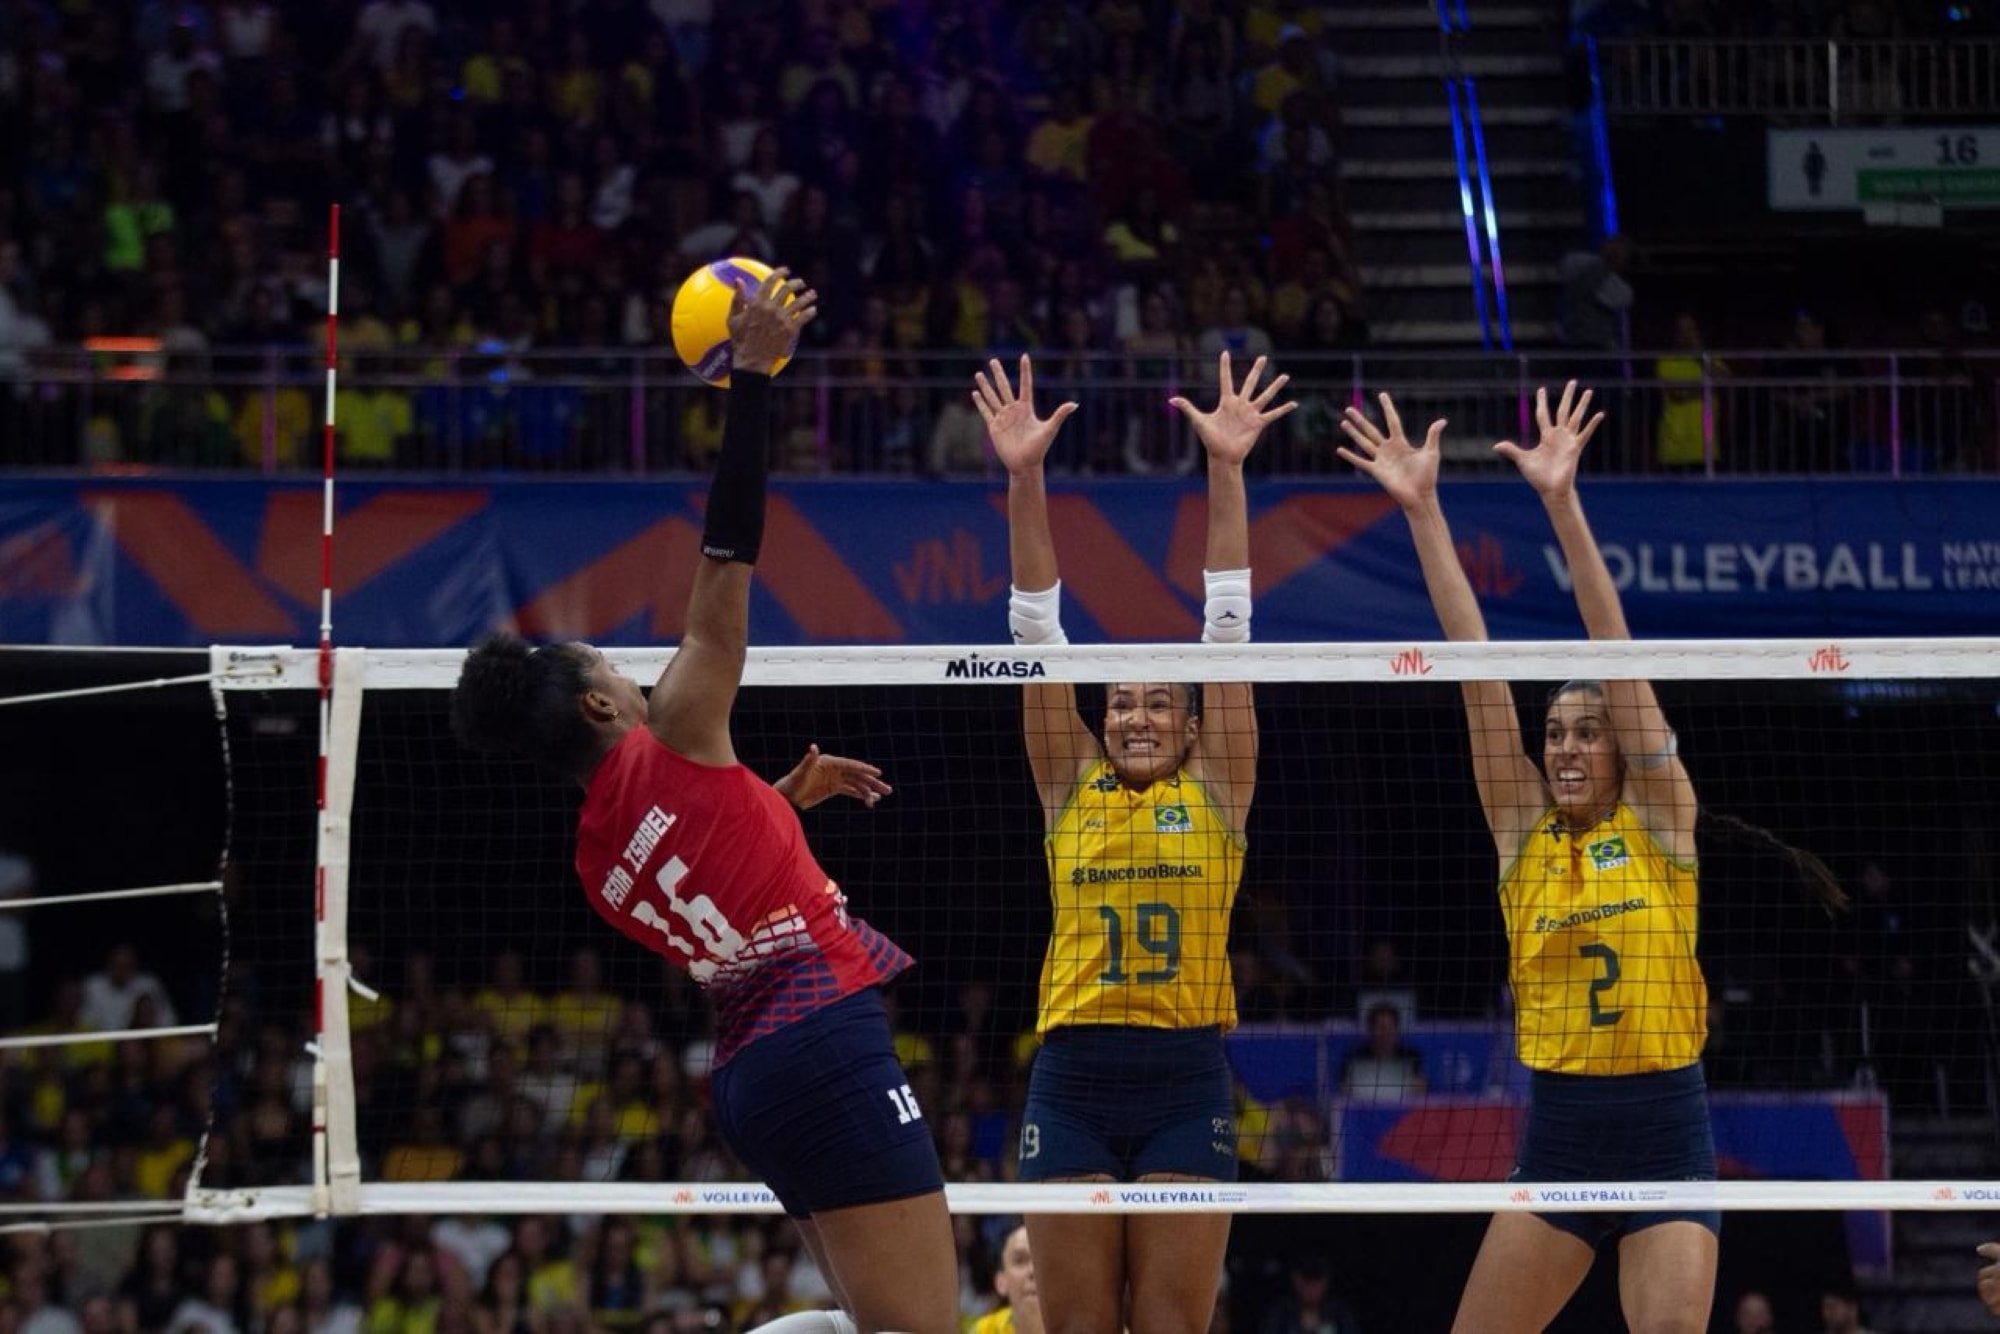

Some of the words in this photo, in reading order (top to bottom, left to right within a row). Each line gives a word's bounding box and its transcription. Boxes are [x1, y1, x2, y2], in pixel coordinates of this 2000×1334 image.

[1935, 135, 1978, 165] 16
[1543, 542, 1932, 591] VOLLEYBALL
[1391, 647, 1433, 675] VNL
[1088, 867, 1135, 884] BANCO
[1137, 866, 1157, 880] DO
[1157, 864, 1204, 880] BRASIL
[631, 854, 752, 986] 16
[1098, 902, 1182, 985] 19
[1578, 942, 1625, 1028] 2
[887, 1085, 923, 1125] 16
[1120, 1192, 1216, 1204] VOLLEYBALL
[1540, 1190, 1636, 1202] VOLLEYBALL
